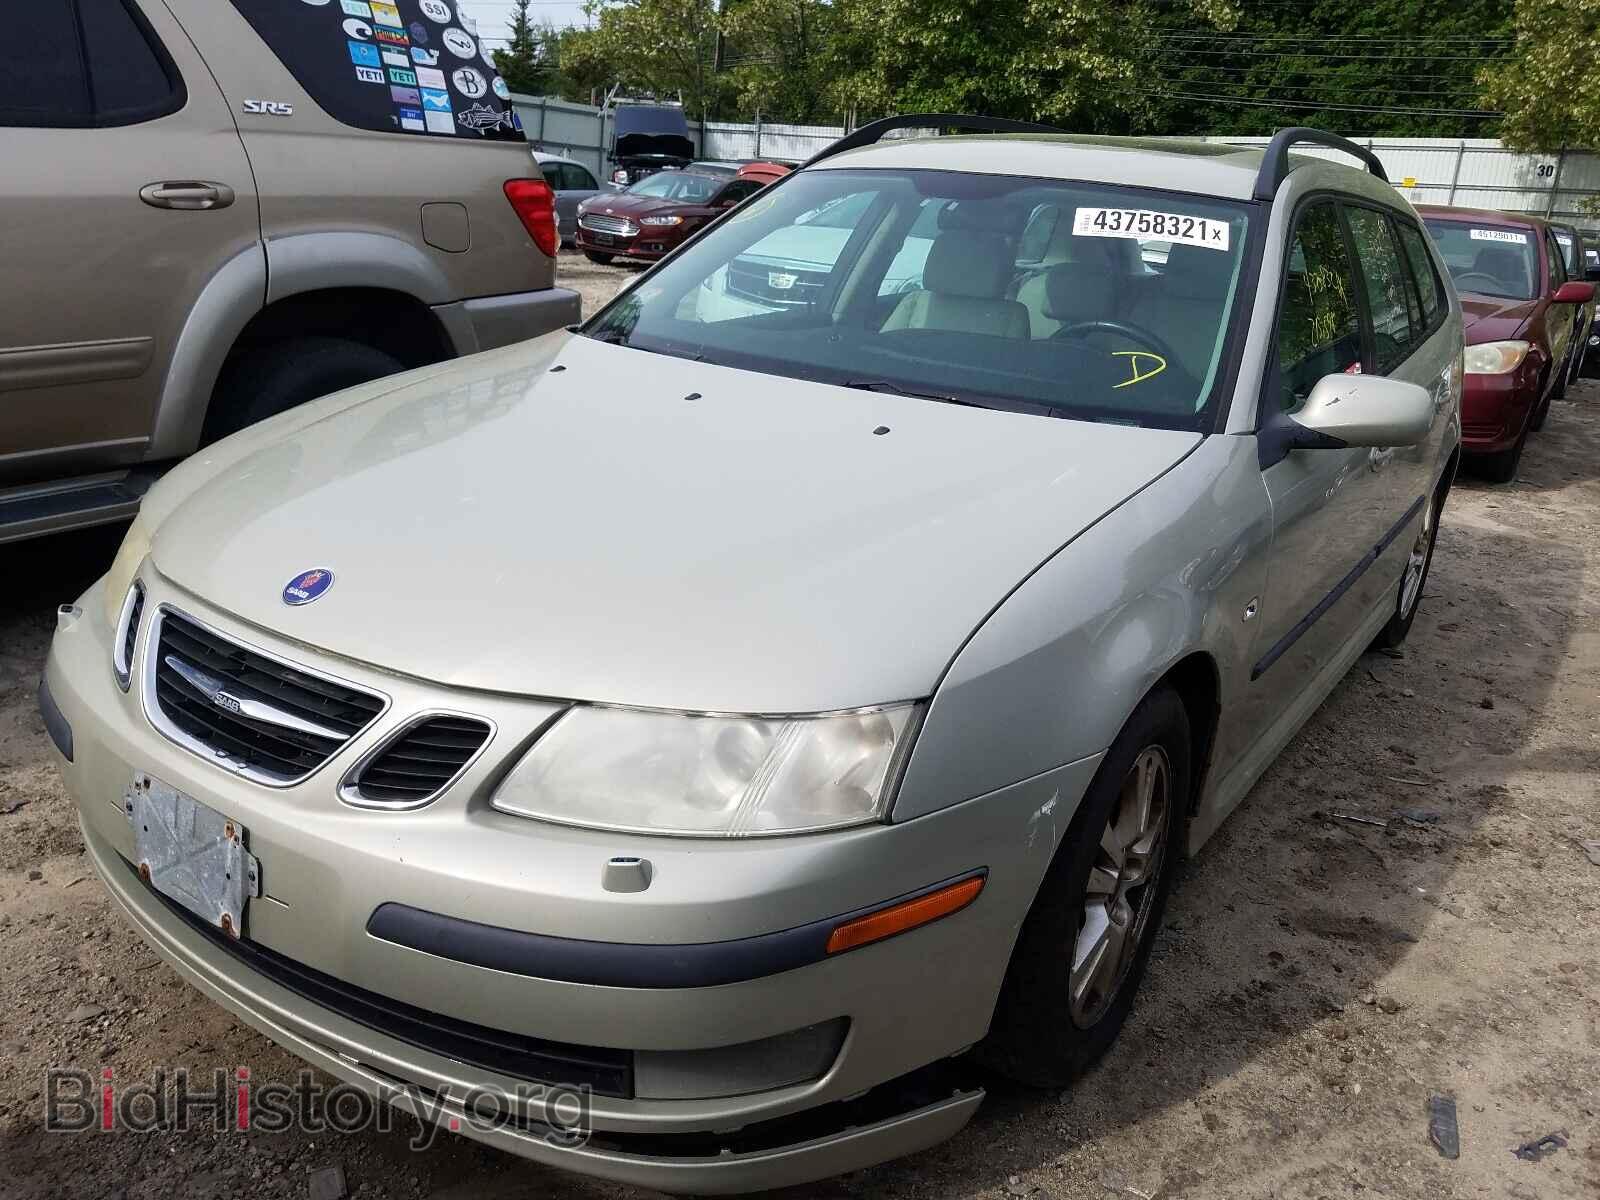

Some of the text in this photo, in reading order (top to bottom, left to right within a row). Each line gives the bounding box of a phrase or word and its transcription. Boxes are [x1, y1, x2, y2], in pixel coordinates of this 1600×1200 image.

[358, 69, 383, 81] YETI
[391, 70, 415, 83] YETI
[1537, 164, 1554, 177] 30
[1093, 210, 1207, 241] 43758321
[286, 586, 310, 599] SAAB
[215, 694, 240, 712] SAAB
